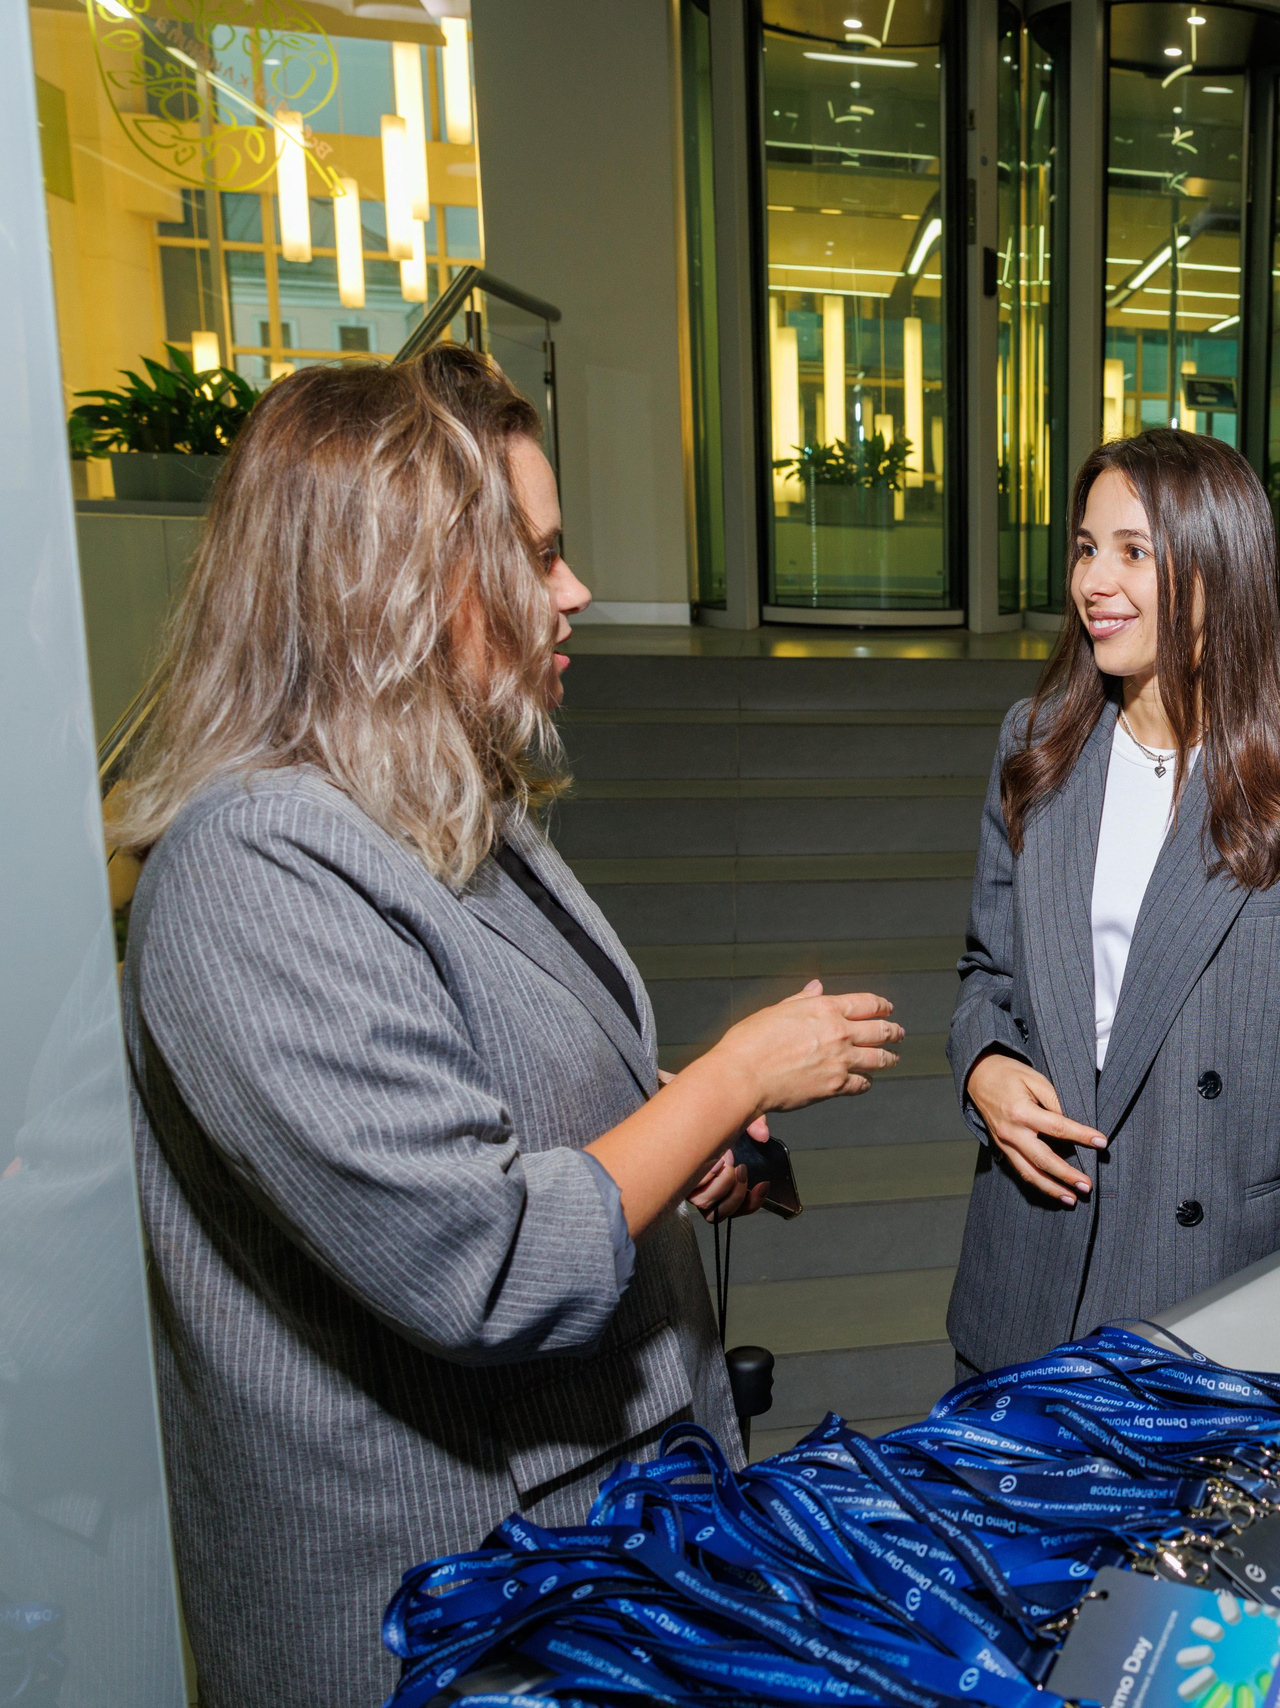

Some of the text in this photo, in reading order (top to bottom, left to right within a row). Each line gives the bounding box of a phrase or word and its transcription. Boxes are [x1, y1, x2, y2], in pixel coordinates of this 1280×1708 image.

[998, 1373, 1019, 1384] Demo
[1019, 1365, 1092, 1379] Региональные
[1195, 1374, 1216, 1391] Day
[1218, 1382, 1251, 1397] Demo
[1094, 1394, 1124, 1408] Demo
[1125, 1399, 1146, 1412] Day
[1132, 1416, 1154, 1429] Day
[1156, 1417, 1188, 1429] Demo
[964, 1430, 998, 1446] Demo
[1000, 1439, 1024, 1452] Day
[1109, 1436, 1124, 1455] Day
[802, 1451, 838, 1463] Demo
[1124, 1446, 1146, 1468] Demo
[1067, 1464, 1099, 1478] Demo
[1090, 1485, 1166, 1499] акселераторов
[961, 1510, 984, 1527] Day
[986, 1516, 1017, 1534] Demo
[897, 1536, 928, 1558] Demo
[883, 1548, 905, 1571] Day
[903, 1563, 932, 1590] Demo
[1107, 1636, 1153, 1708] mo Day
